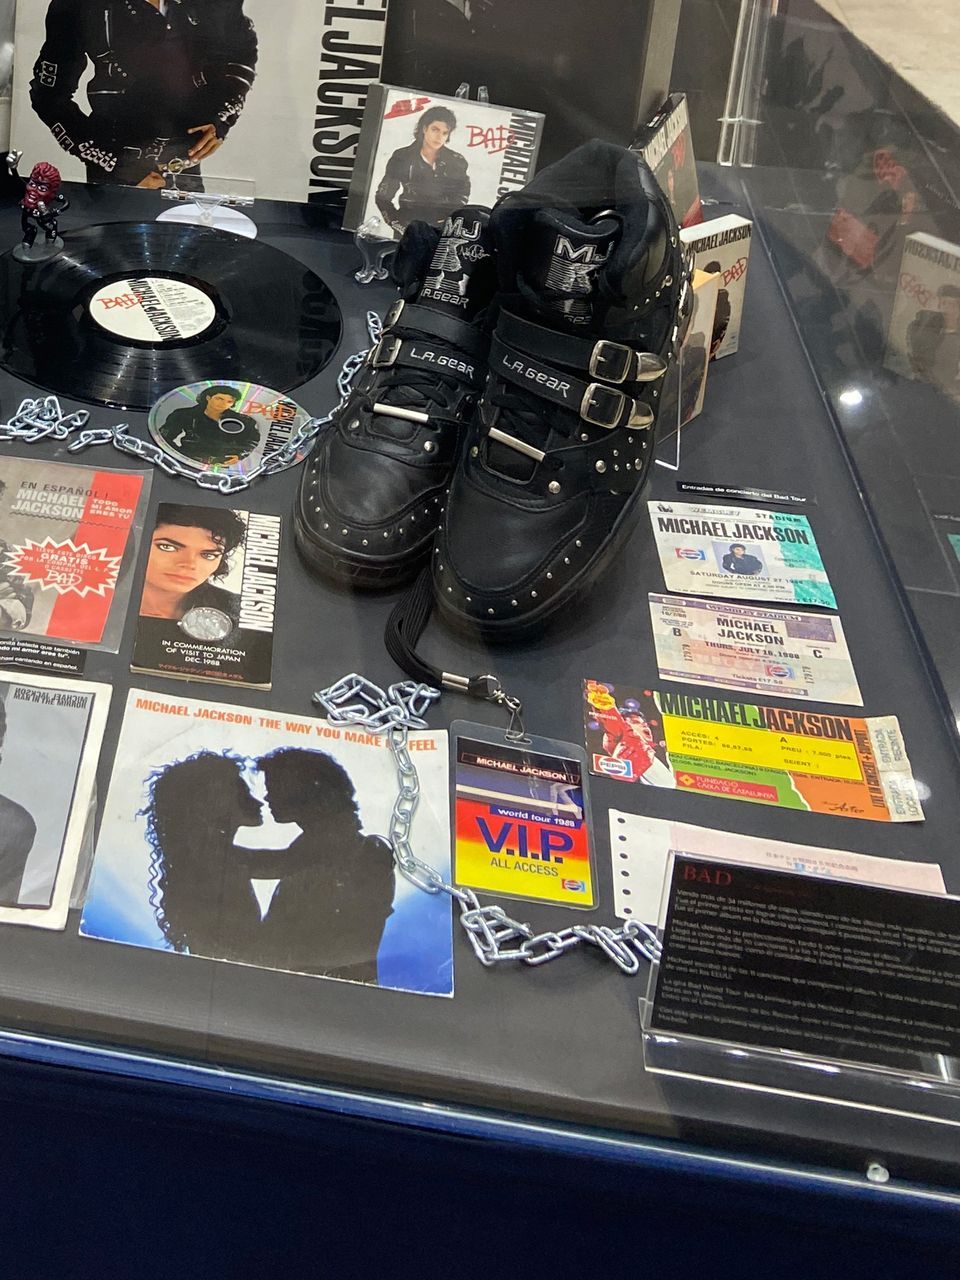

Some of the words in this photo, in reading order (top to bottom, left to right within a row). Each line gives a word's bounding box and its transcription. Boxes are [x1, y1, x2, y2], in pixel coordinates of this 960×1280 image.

[307, 28, 384, 204] JACKSON
[466, 124, 516, 154] BAD
[499, 113, 537, 186] MICHAEL
[442, 217, 481, 241] MJ
[719, 224, 752, 246] JACKSON
[720, 256, 748, 288] BAD
[97, 293, 144, 309] BAD
[127, 280, 162, 309] MICHAEL
[144, 306, 182, 340] JACKSON
[16, 489, 86, 508] MICHAEL
[20, 481, 37, 490] EN
[43, 483, 99, 498] ESPAÑOL
[682, 484, 714, 492] Entradas
[726, 488, 759, 497] concierto
[11, 500, 84, 519] JACKSON
[92, 499, 118, 507] TODO
[105, 506, 132, 514] AMOR
[90, 509, 115, 518] ERES
[657, 517, 731, 538] MICHAEL
[733, 525, 810, 545] JACKSON
[246, 513, 281, 568] MICHAEL
[41, 552, 89, 565] GRATIS
[44, 569, 82, 587] BAD
[690, 570, 734, 580] SATURDAY
[737, 574, 770, 582] AUGUST
[239, 567, 277, 633] JACKSON
[709, 604, 755, 616] WEMBLEY
[757, 612, 800, 621] STADIUM
[717, 618, 779, 634] MICHAEL
[718, 629, 784, 646] JACKSON
[17, 641, 38, 649] balada
[54, 646, 80, 656] también
[162, 639, 171, 647] IN
[174, 640, 246, 656] COMMEMORATION
[180, 649, 199, 657] VISIT
[216, 653, 241, 663] JAPAN
[739, 646, 760, 655] JULY
[15, 656, 43, 665] cantando
[185, 656, 202, 664] DEC.
[203, 658, 220, 666] 1988
[136, 698, 190, 717] MICHAEL
[194, 708, 252, 725] JACKSON
[259, 717, 281, 730] THE
[285, 721, 313, 735] WAY
[316, 727, 341, 740] YOU
[344, 731, 382, 747] MAKE
[409, 739, 437, 751] FEEL
[659, 692, 750, 727] MICHAEL
[752, 707, 853, 741] JACKSON
[477, 757, 518, 772] MICHAEL
[520, 767, 567, 781] JACKSON
[600, 761, 626, 771] PEPSI
[498, 809, 528, 820] world
[531, 813, 551, 823] tour
[476, 816, 574, 864] V.I.P.
[491, 857, 511, 869] ALL
[514, 862, 559, 877] ACCESS
[683, 865, 733, 886] BAD
